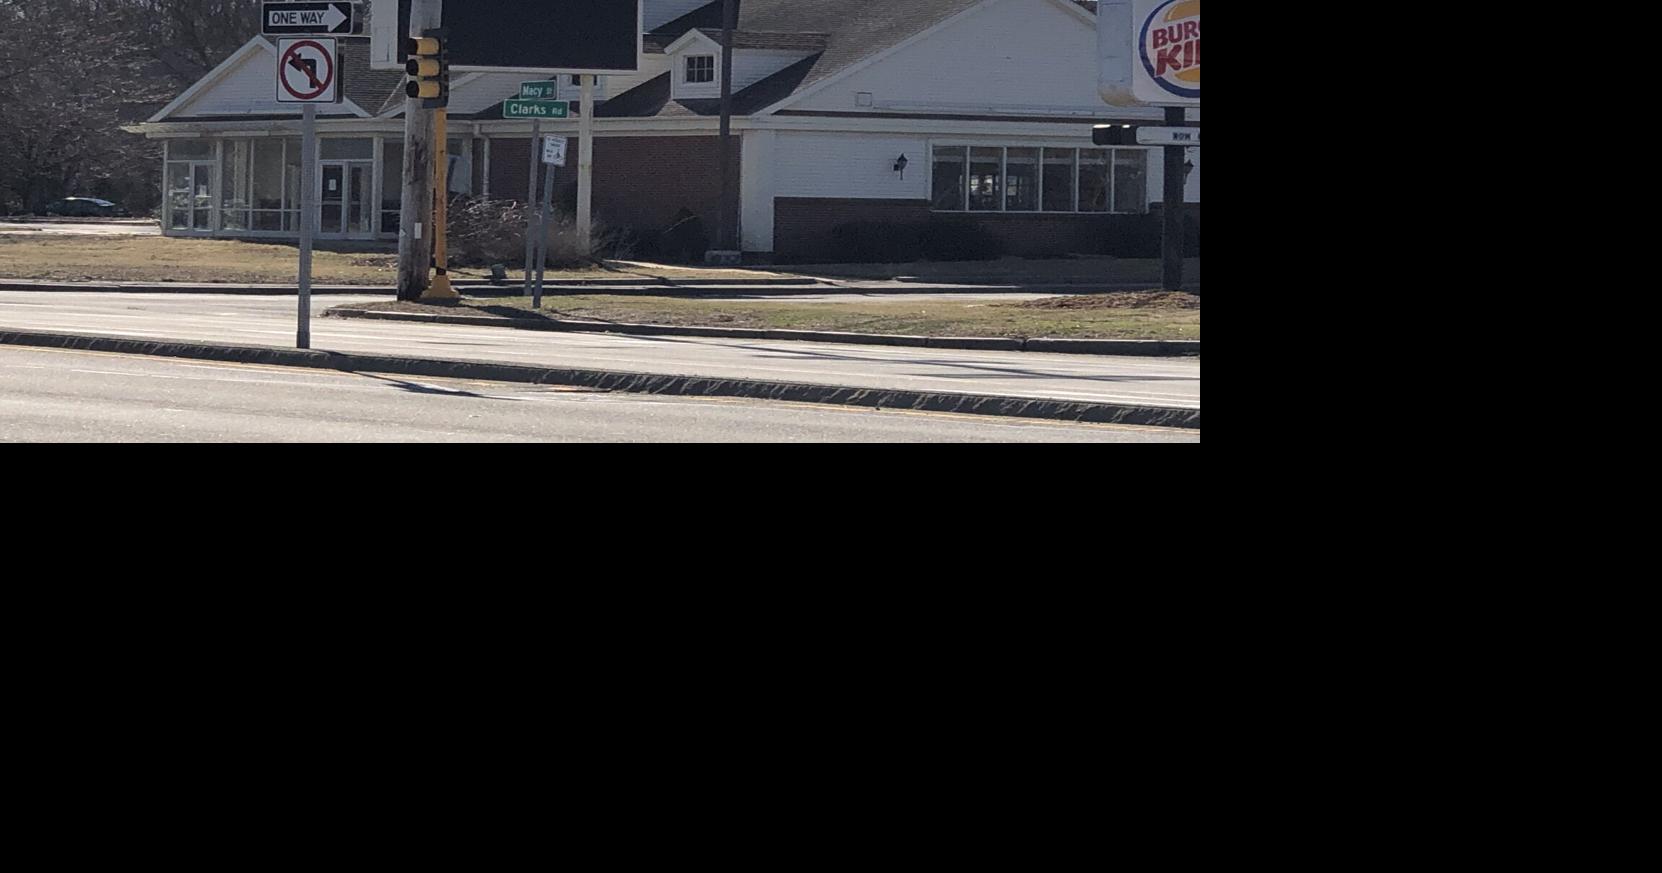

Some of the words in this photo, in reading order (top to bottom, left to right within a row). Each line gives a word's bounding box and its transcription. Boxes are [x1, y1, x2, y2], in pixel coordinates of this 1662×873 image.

[271, 12, 297, 24] ONE
[300, 12, 325, 24] WAY
[1152, 20, 1200, 49] BUR
[1156, 39, 1200, 76] KI
[522, 85, 543, 98] Macy
[510, 103, 546, 115] Clarks
[552, 106, 563, 115] Rd
[1173, 132, 1191, 140] NOW
